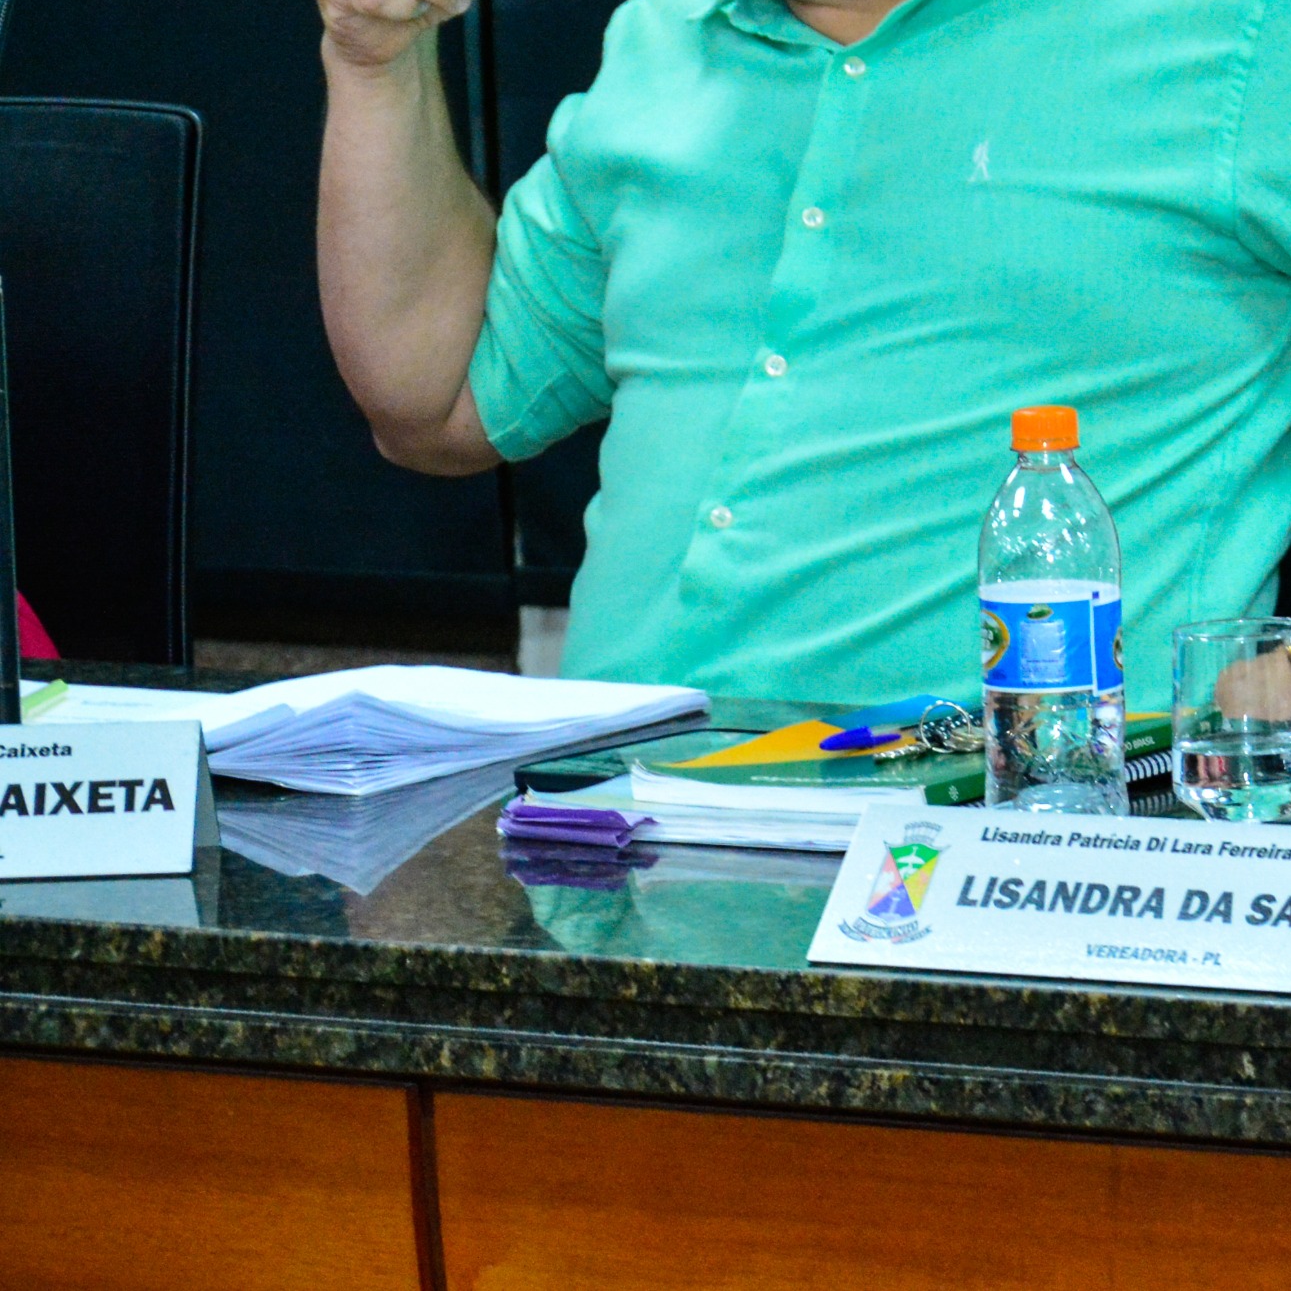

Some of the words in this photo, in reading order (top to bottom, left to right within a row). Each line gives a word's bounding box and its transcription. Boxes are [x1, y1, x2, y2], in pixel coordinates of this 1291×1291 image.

[981, 827, 1062, 846] Lisandra
[1067, 831, 1140, 851] Patrícia
[1146, 836, 1166, 853] Di
[1171, 838, 1213, 856] Lara
[956, 875, 1166, 919] LISANDRA
[1176, 888, 1234, 924] DA
[1086, 943, 1188, 964] VEREADORA
[1201, 951, 1222, 966] PL
